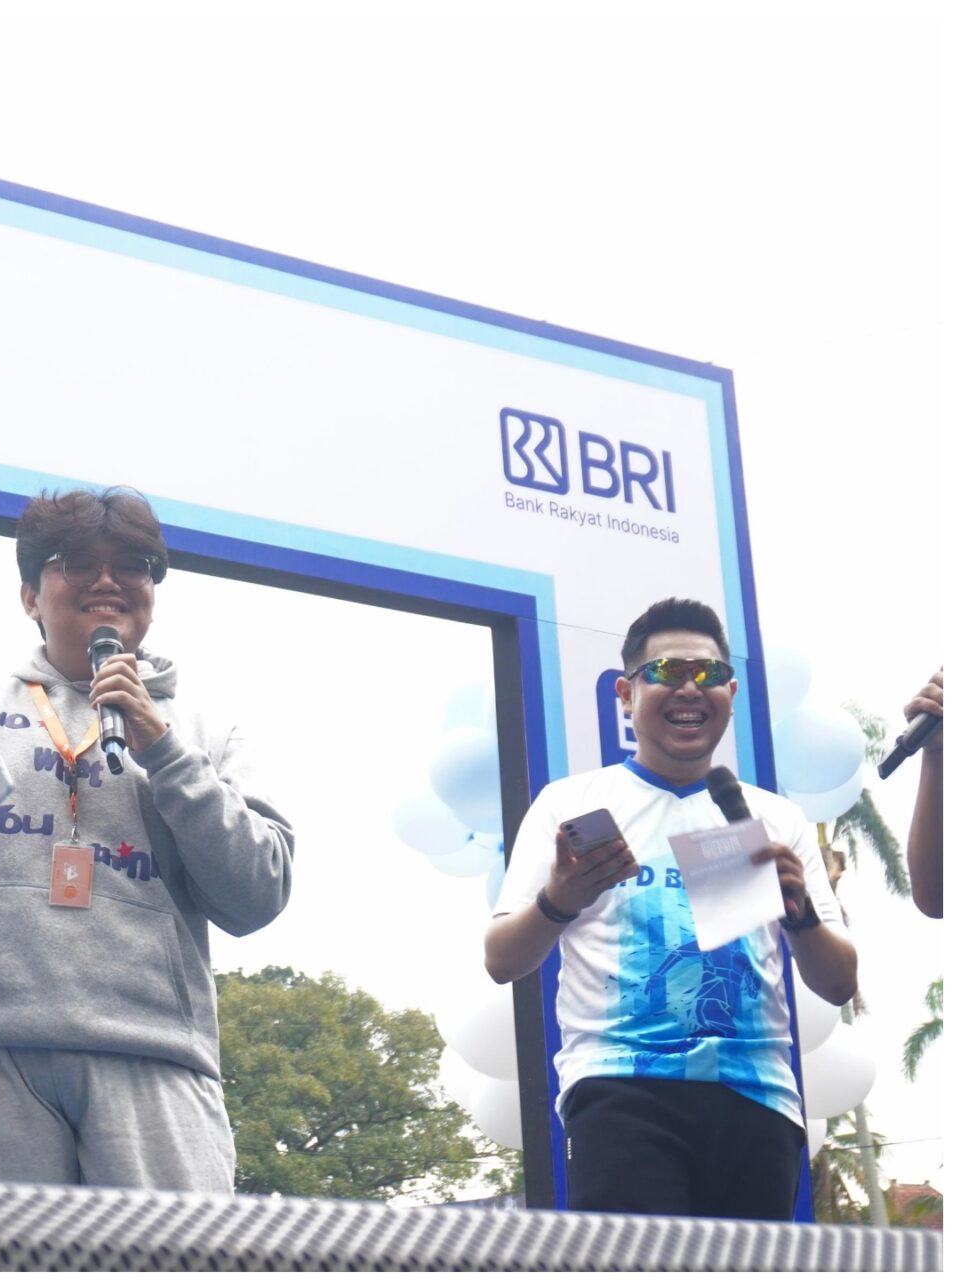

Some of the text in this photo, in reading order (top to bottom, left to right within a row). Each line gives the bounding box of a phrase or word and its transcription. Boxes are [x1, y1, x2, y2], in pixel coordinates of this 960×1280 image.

[578, 430, 677, 513] BRI
[505, 491, 680, 544] Bank Rakyat Indonesia
